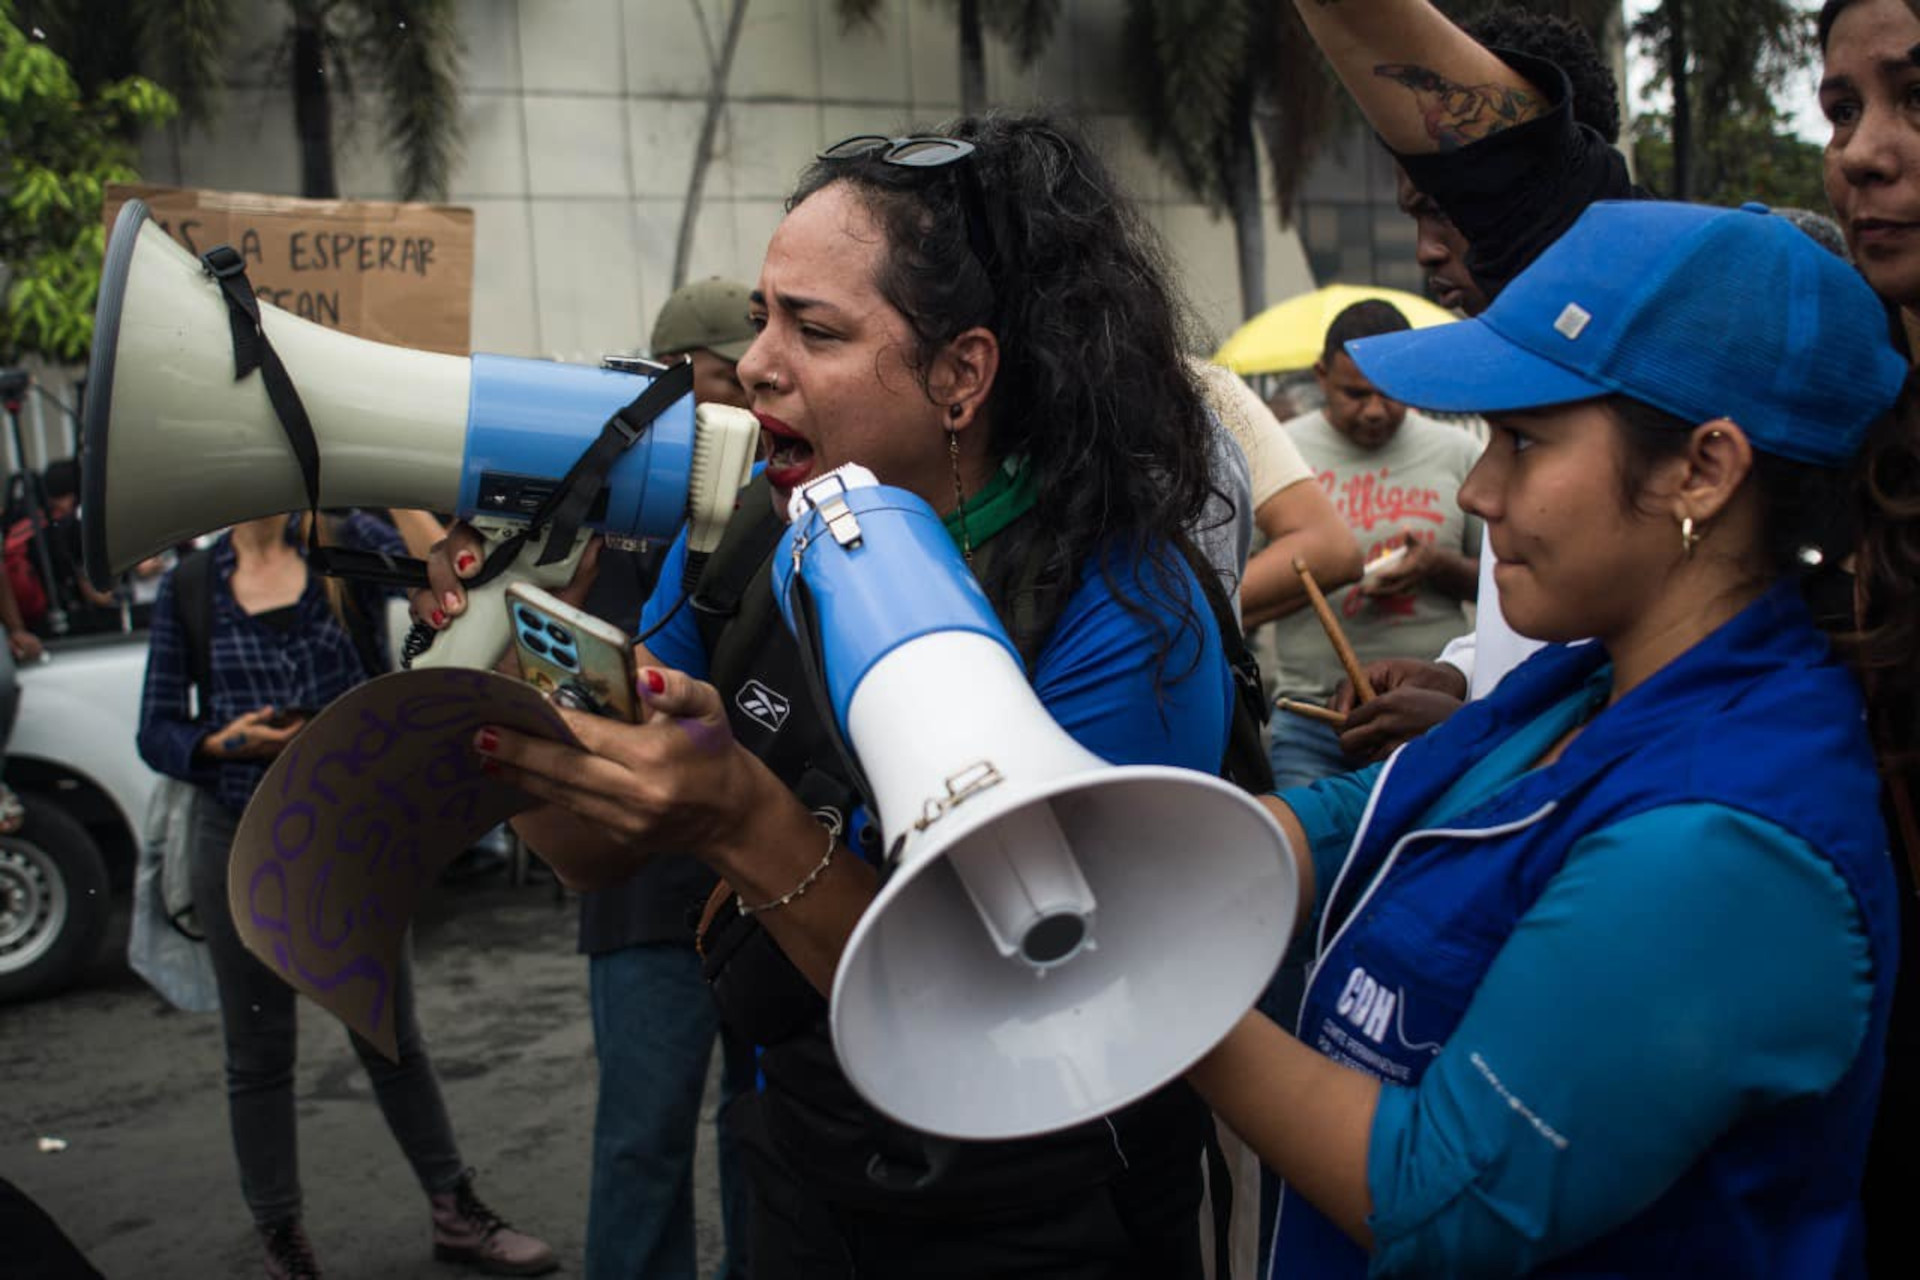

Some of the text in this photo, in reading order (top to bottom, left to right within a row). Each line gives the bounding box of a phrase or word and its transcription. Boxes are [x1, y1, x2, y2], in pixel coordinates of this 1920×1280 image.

[241, 227, 263, 264] A
[289, 230, 437, 277] ESPERAR
[1311, 466, 1446, 531] ilfiger
[1336, 966, 1397, 1044] CDH
